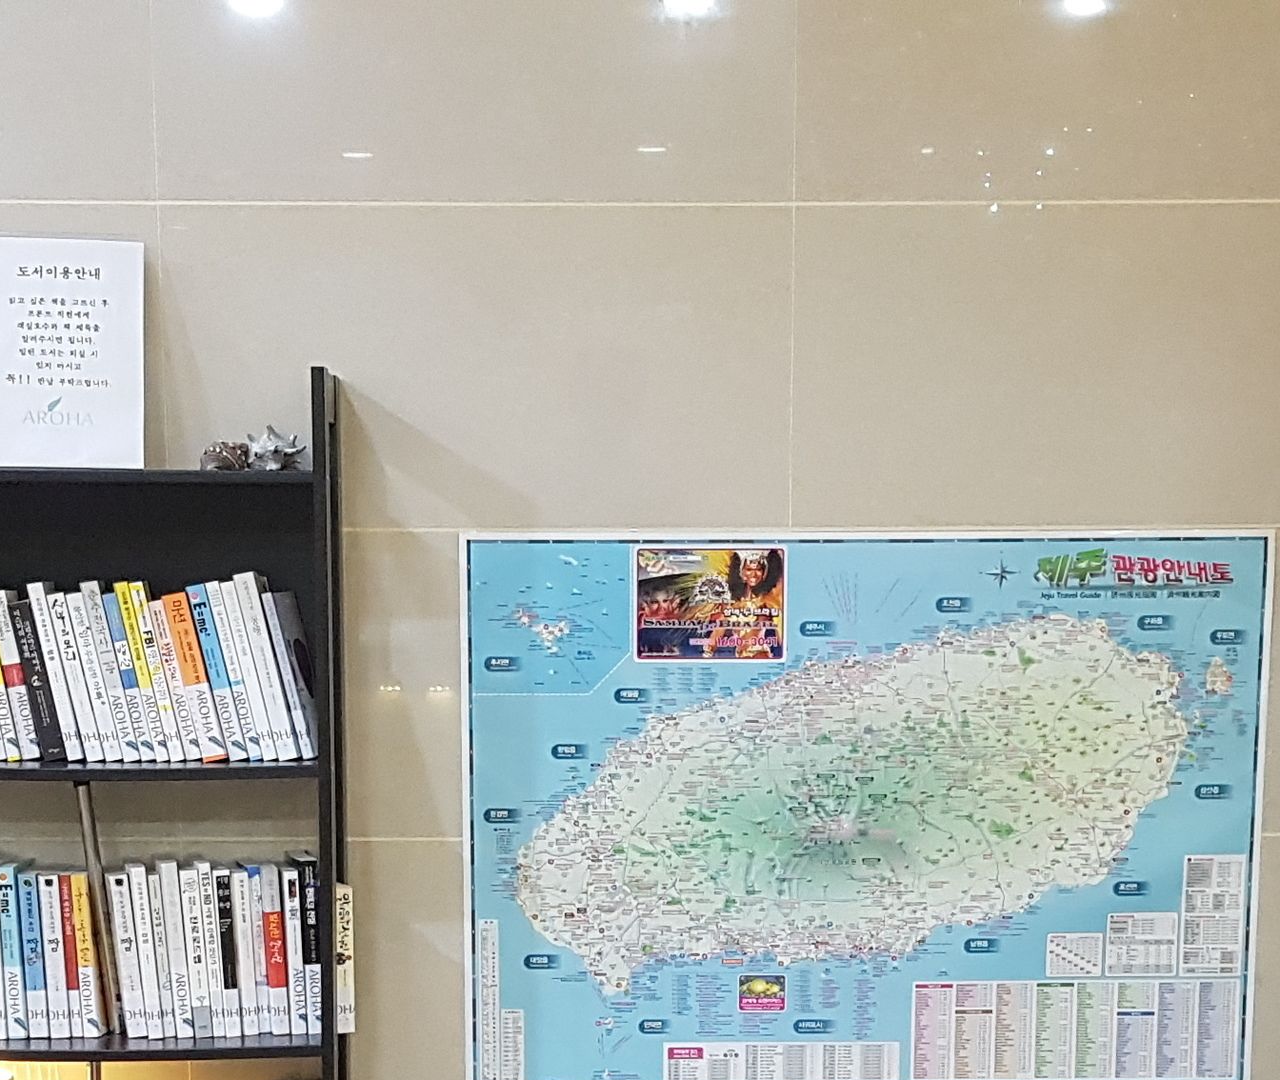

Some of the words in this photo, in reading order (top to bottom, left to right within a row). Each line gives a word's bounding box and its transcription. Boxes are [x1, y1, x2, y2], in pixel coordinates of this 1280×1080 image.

[16, 265, 101, 281] 도서이용안내
[9, 297, 25, 305] 읽고
[30, 297, 46, 305] 싶은
[51, 298, 66, 306] 책을
[72, 299, 96, 307] 고르신
[102, 299, 109, 308] 후
[27, 310, 52, 318] 프론트
[57, 310, 90, 319] 직원에게
[76, 323, 100, 332] 제목을
[21, 334, 63, 345] 알려주시면
[68, 336, 96, 345] 됩니다.
[19, 347, 35, 356] 빌린
[40, 348, 65, 358] 도서는
[90, 350, 98, 358] 시
[56, 362, 81, 371] 마시고
[37, 377, 53, 386] 반납
[59, 378, 111, 387] 부탁드립니다.
[23, 410, 95, 426] AROHA
[1111, 554, 1234, 585] 관광안내도
[1040, 591, 1055, 600] Jeju
[1057, 591, 1078, 599] Travel
[1080, 591, 1102, 599] Guide
[172, 600, 188, 624] 마션
[142, 630, 155, 649] FBI
[16, 691, 35, 739] AROHA
[110, 693, 129, 739] AROHA
[127, 693, 145, 738] AROHA
[142, 693, 162, 738] AROHA
[173, 692, 193, 737] AROHA
[196, 689, 214, 734] AROHA
[216, 694, 235, 739] AROHA
[234, 690, 252, 738] AROHA
[200, 871, 210, 888] YES
[203, 893, 212, 905] NO
[7, 971, 20, 1015] AROHA
[81, 972, 93, 1016] AROHA
[175, 972, 188, 1016] AROHA
